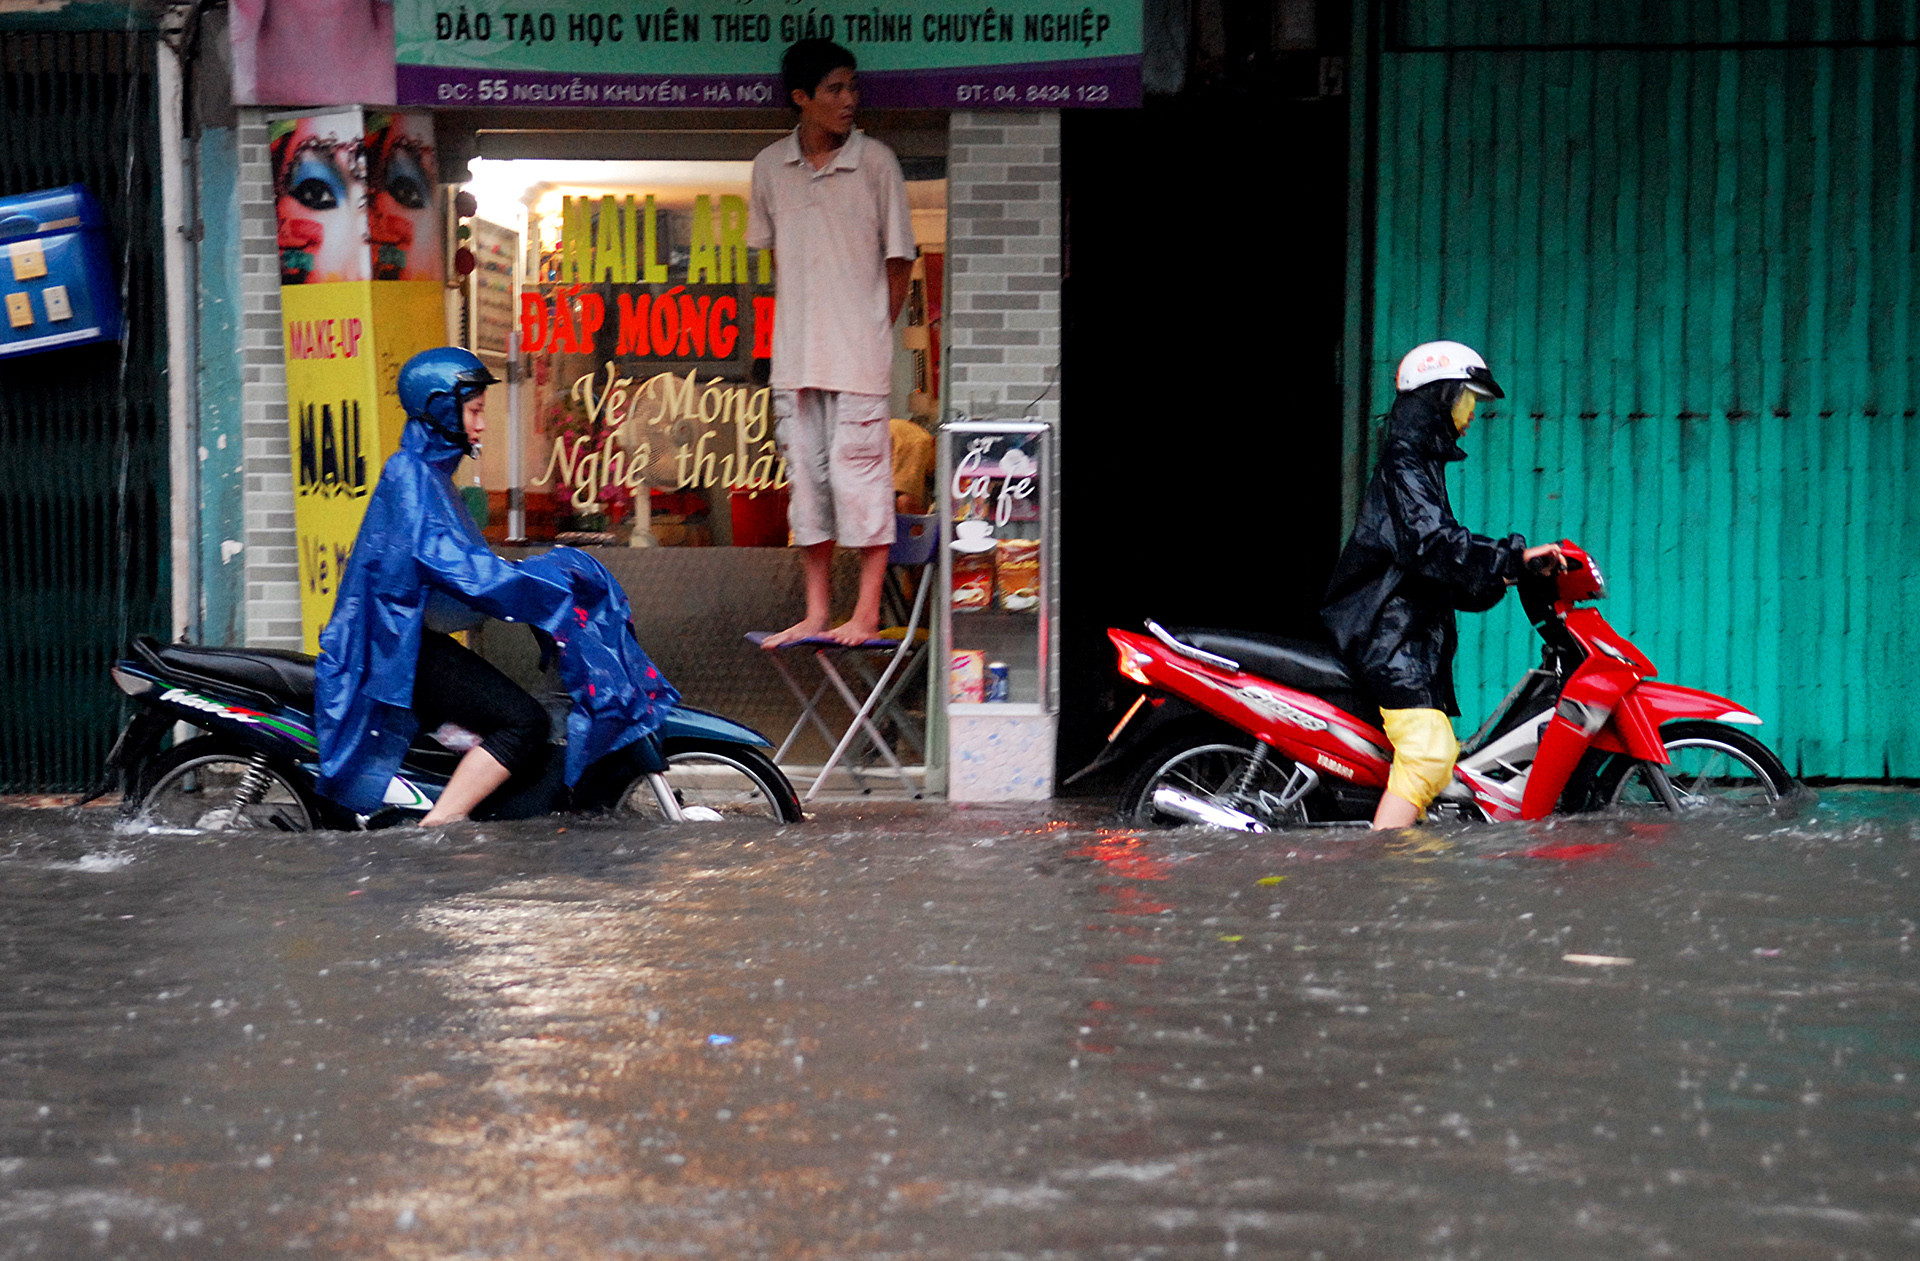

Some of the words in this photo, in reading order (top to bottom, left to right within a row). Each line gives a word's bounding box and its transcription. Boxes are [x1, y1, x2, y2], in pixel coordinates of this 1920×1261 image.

[436, 5, 491, 41] ĐÀO
[503, 13, 556, 46] TẠO
[568, 13, 624, 46] HỌC
[635, 7, 699, 42] VIÊN
[712, 13, 771, 42] THEO
[780, 7, 835, 42] GIÁO
[843, 6, 913, 42] TRÌNH
[923, 7, 1013, 42] CHUYÊN
[1024, 7, 1111, 47] NGHIỆP
[437, 83, 474, 100] ĐC:
[478, 79, 509, 100] 55
[603, 79, 687, 101] KHUYẾN
[703, 81, 732, 101] HÀ
[736, 81, 773, 103] NỘI
[957, 84, 990, 101] ĐT:
[1076, 84, 1110, 102] 123
[560, 194, 668, 285] NAIL
[289, 317, 363, 360] MAKE-UP
[616, 285, 739, 359] MÓNG
[571, 360, 634, 426] Vẽ
[648, 367, 771, 444] Móng
[298, 399, 367, 492] NAIL
[531, 428, 651, 508] Nghệ
